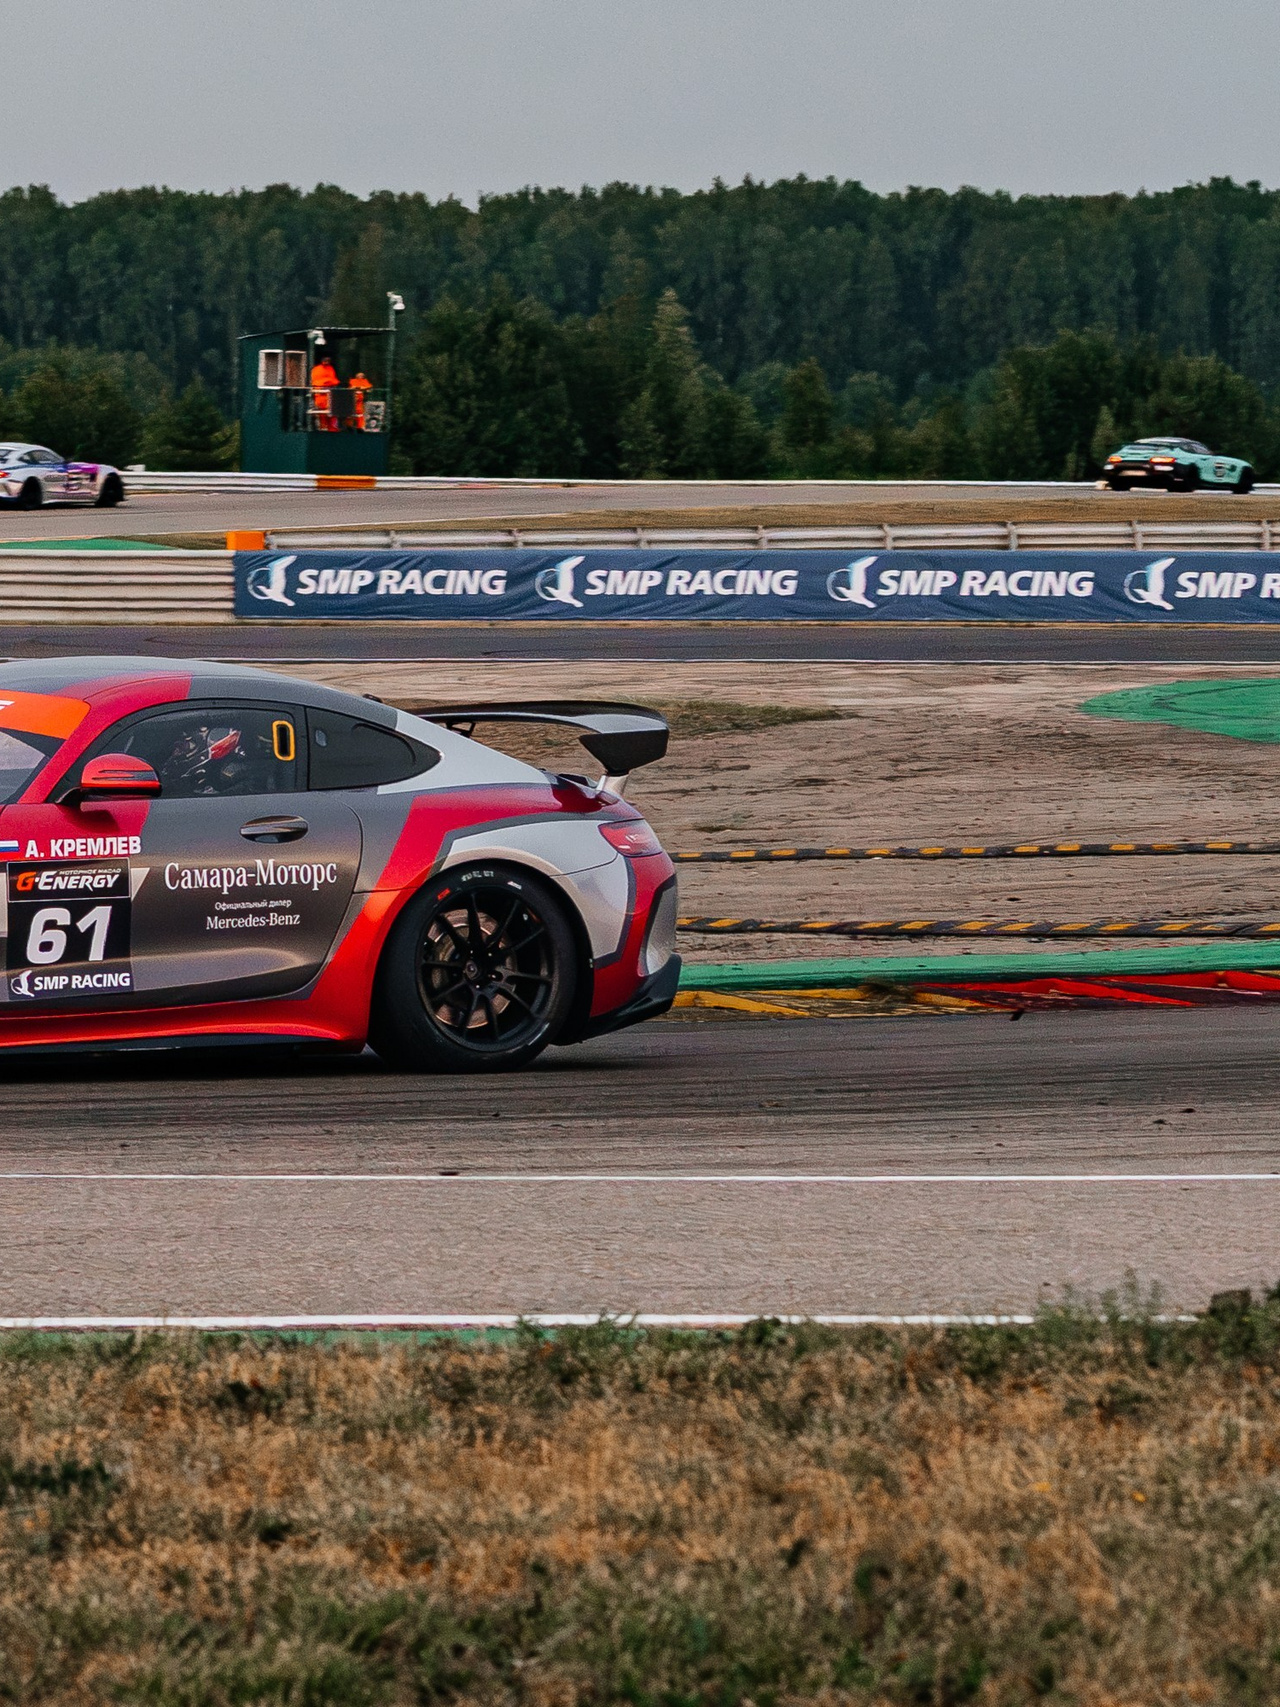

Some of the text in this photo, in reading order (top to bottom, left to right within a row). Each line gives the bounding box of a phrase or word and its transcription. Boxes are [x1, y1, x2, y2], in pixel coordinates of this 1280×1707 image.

[295, 569, 508, 595] SMP RACING
[584, 569, 799, 596] SMP RACING
[876, 569, 1095, 597] SMP RACING
[1174, 571, 1257, 598] SMP
[50, 836, 141, 857] КРЕМЛЕВ
[164, 858, 337, 895] Самара-Моторс
[26, 905, 113, 965] 61
[206, 912, 301, 931] Mercedes-Benz
[33, 972, 131, 991] SMP RACING
